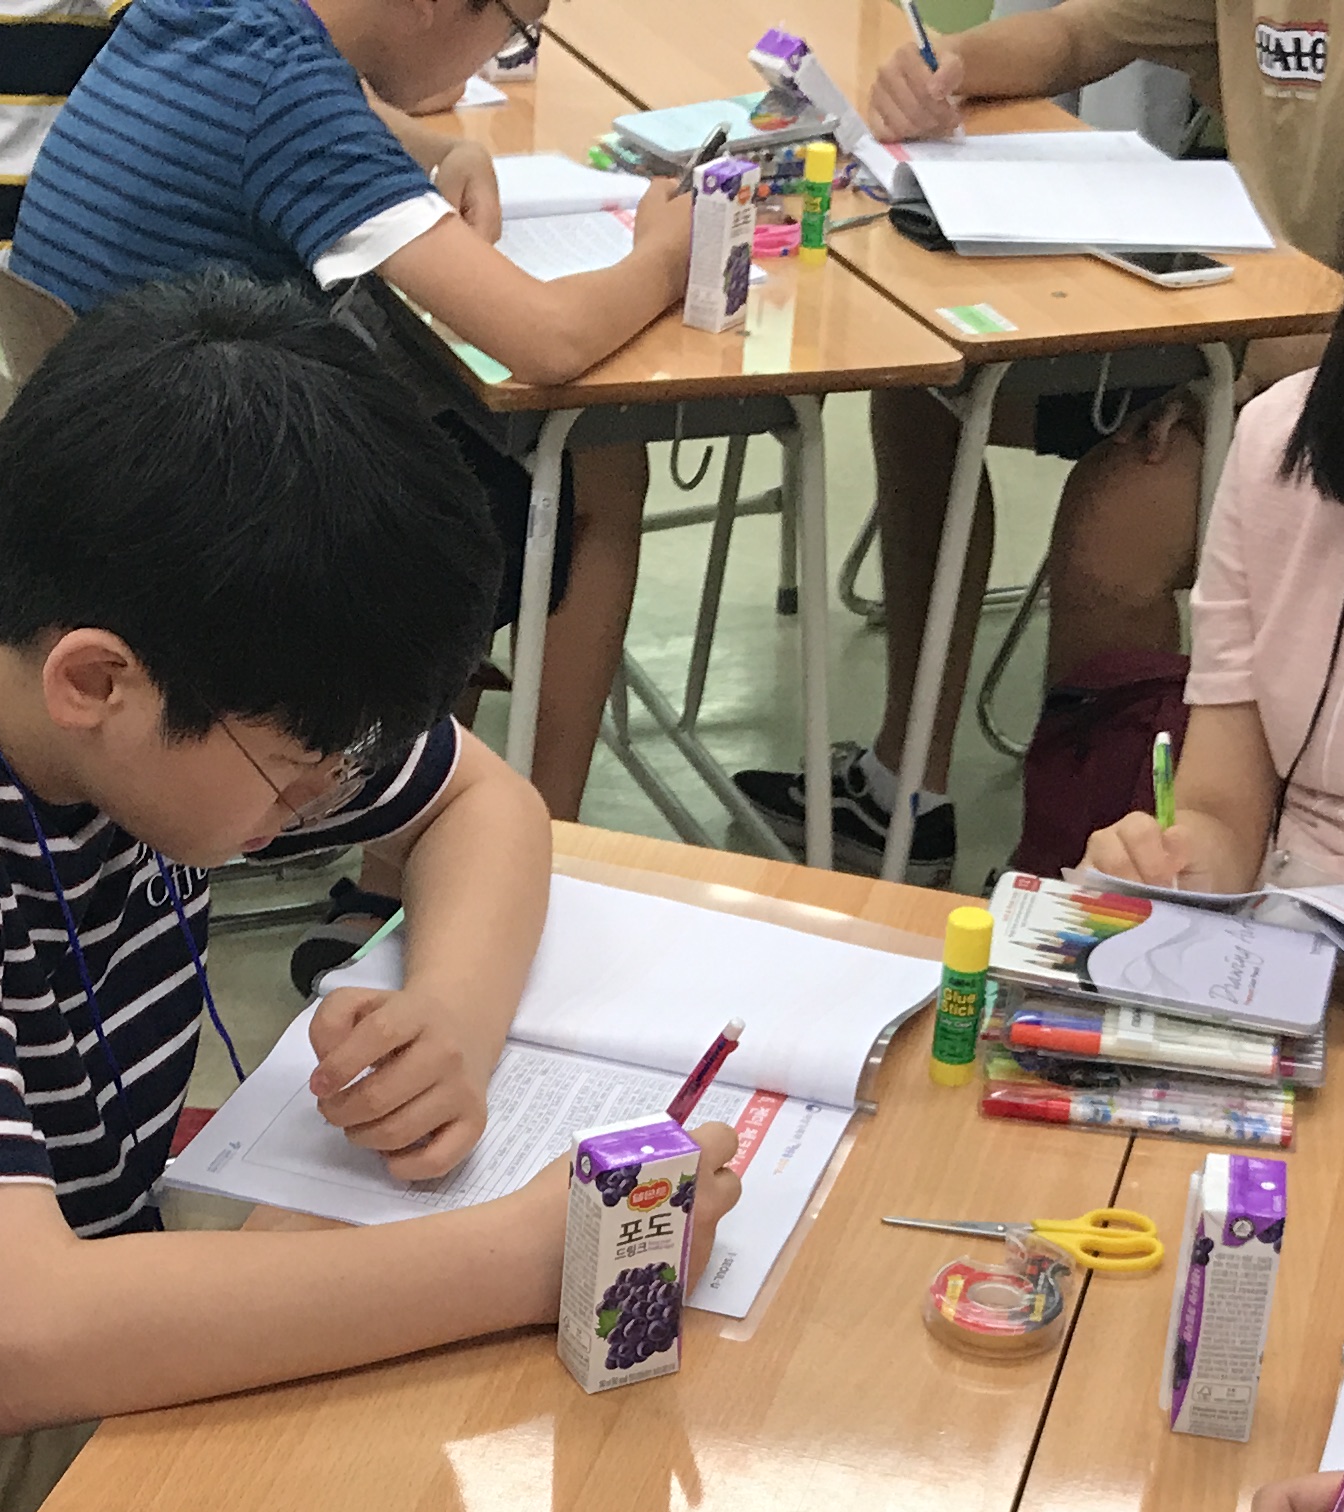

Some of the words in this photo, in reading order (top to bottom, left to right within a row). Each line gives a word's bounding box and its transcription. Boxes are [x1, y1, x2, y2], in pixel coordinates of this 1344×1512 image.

[943, 987, 977, 1006] Glue
[941, 1000, 975, 1018] Stick
[616, 1212, 674, 1247] 포도
[614, 1242, 648, 1261] 드링크
